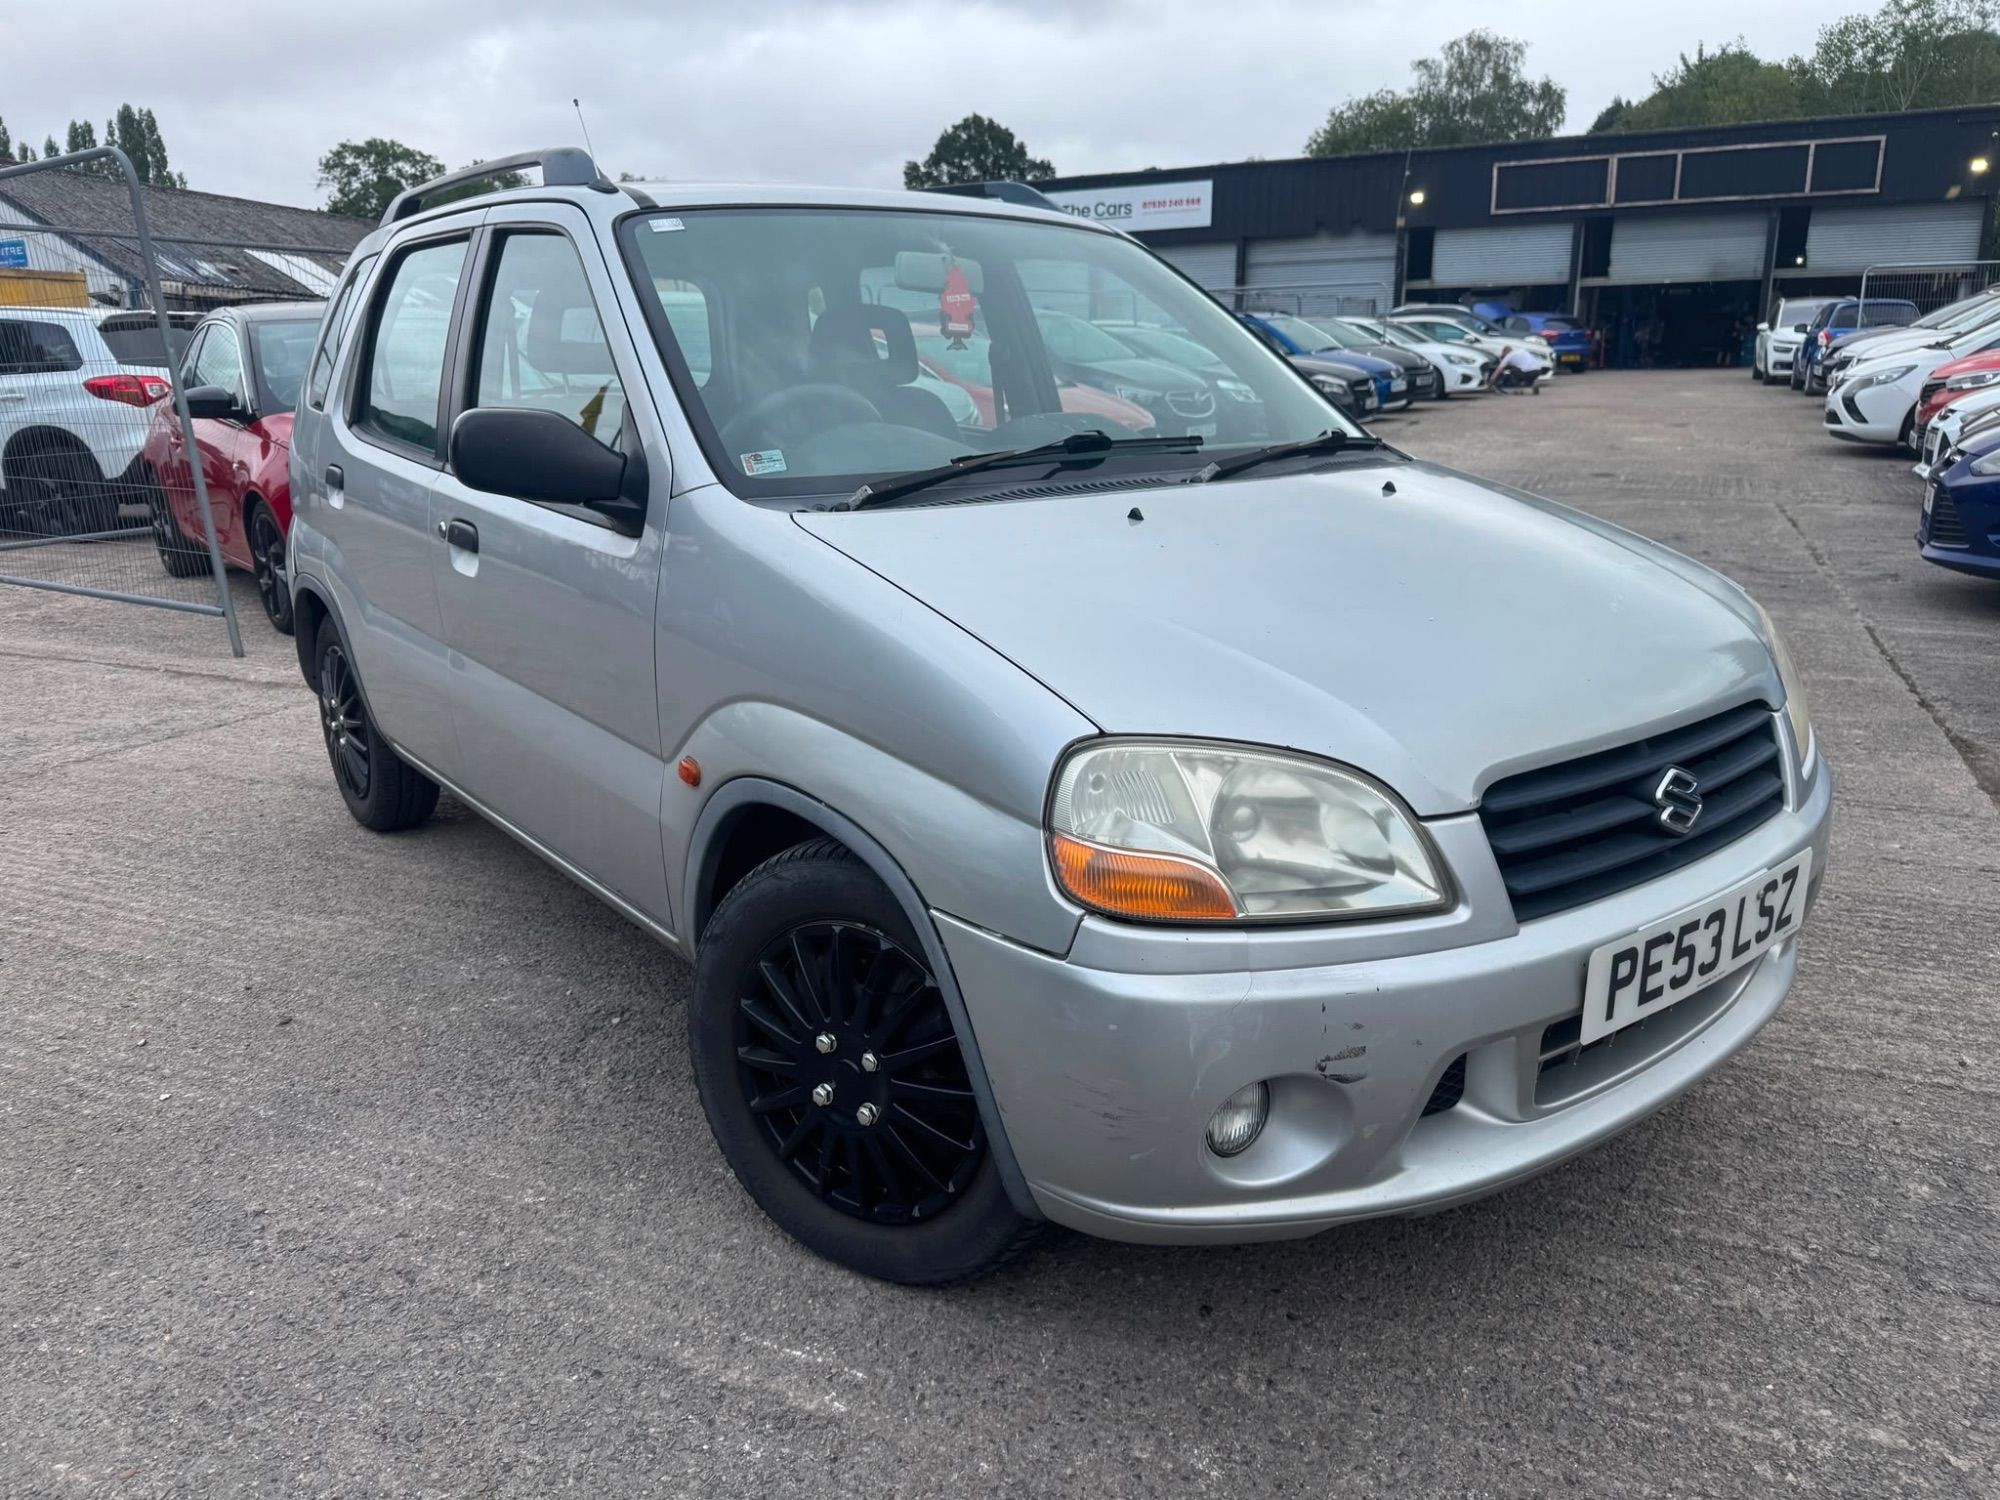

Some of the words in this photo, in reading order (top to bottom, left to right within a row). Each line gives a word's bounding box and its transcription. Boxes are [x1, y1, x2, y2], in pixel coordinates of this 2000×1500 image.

[1094, 202, 1133, 217] Cars
[1605, 908, 1726, 1022] PE53
[1731, 864, 1800, 960] LSZ
